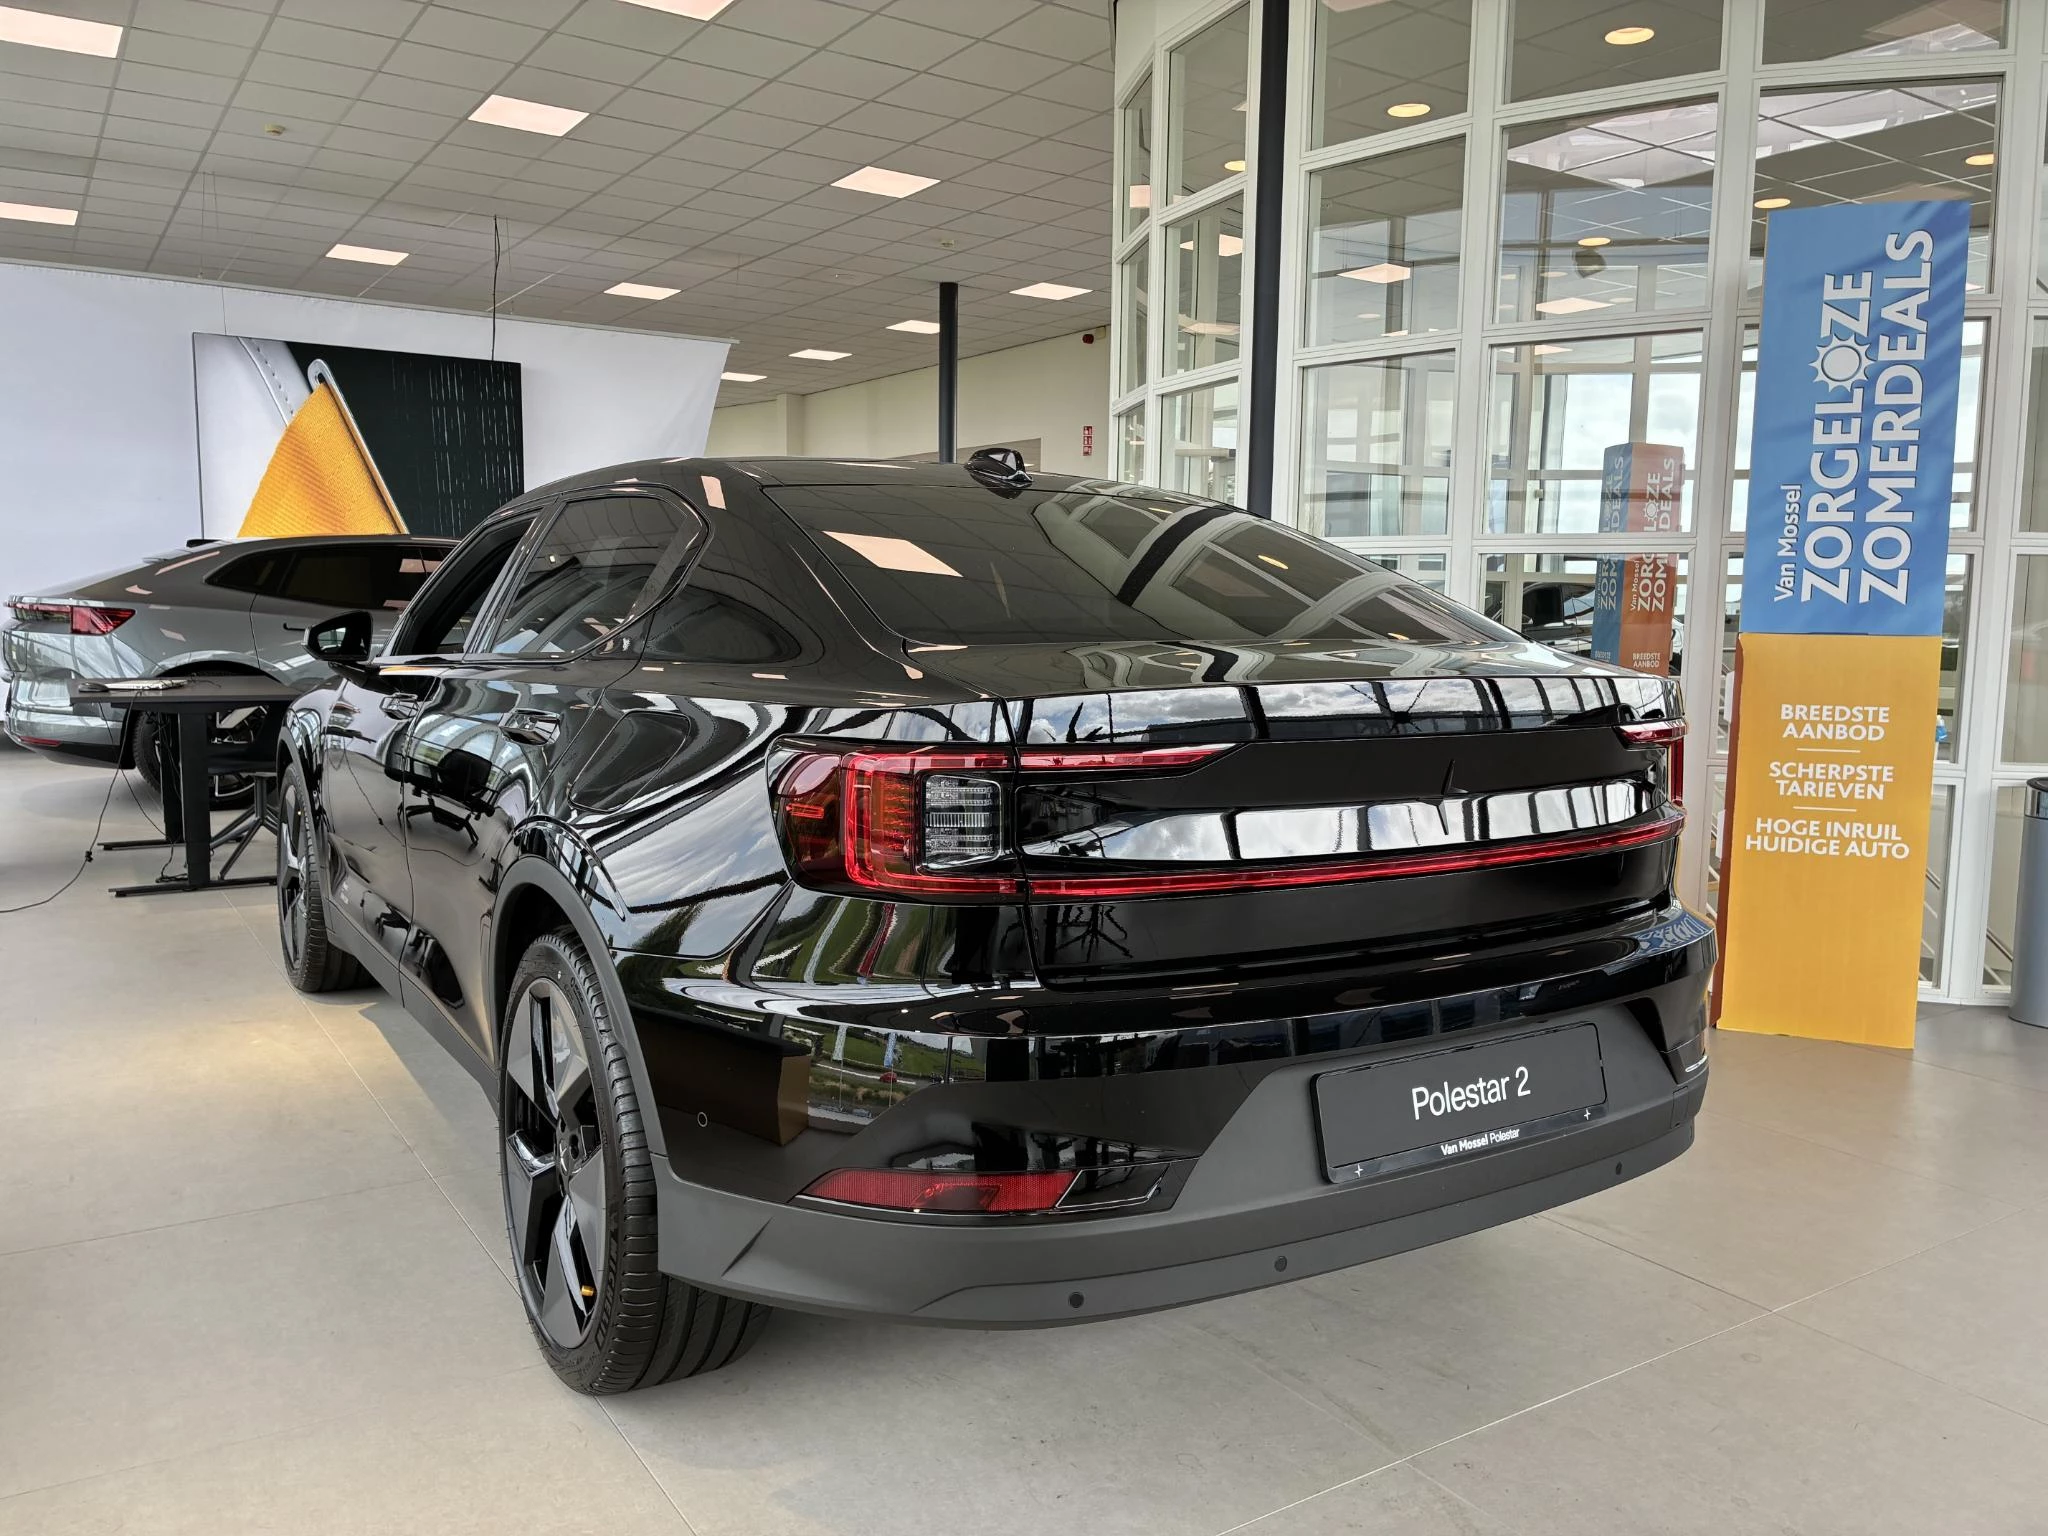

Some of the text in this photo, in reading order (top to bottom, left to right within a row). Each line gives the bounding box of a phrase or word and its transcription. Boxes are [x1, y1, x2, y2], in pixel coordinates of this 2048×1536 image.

[1858, 229, 1934, 606] ZOMERDEALS
[1773, 484, 1802, 602] Van Mossel
[1632, 652, 1661, 660] BREEDSTE
[1633, 660, 1660, 668] AANBOD
[1780, 703, 1890, 723] BREEDSTE
[1782, 722, 1885, 741] AANBOD
[1768, 761, 1895, 782] SCHERPSTE
[1775, 779, 1885, 801] TARIEVEN
[1756, 817, 1902, 841] HOGE INRUIL
[1745, 835, 1910, 859] HUIDIGE AUTO
[1411, 1066, 1531, 1120] Polestar 2
[1440, 1128, 1520, 1156] Van Mossel Polestar
